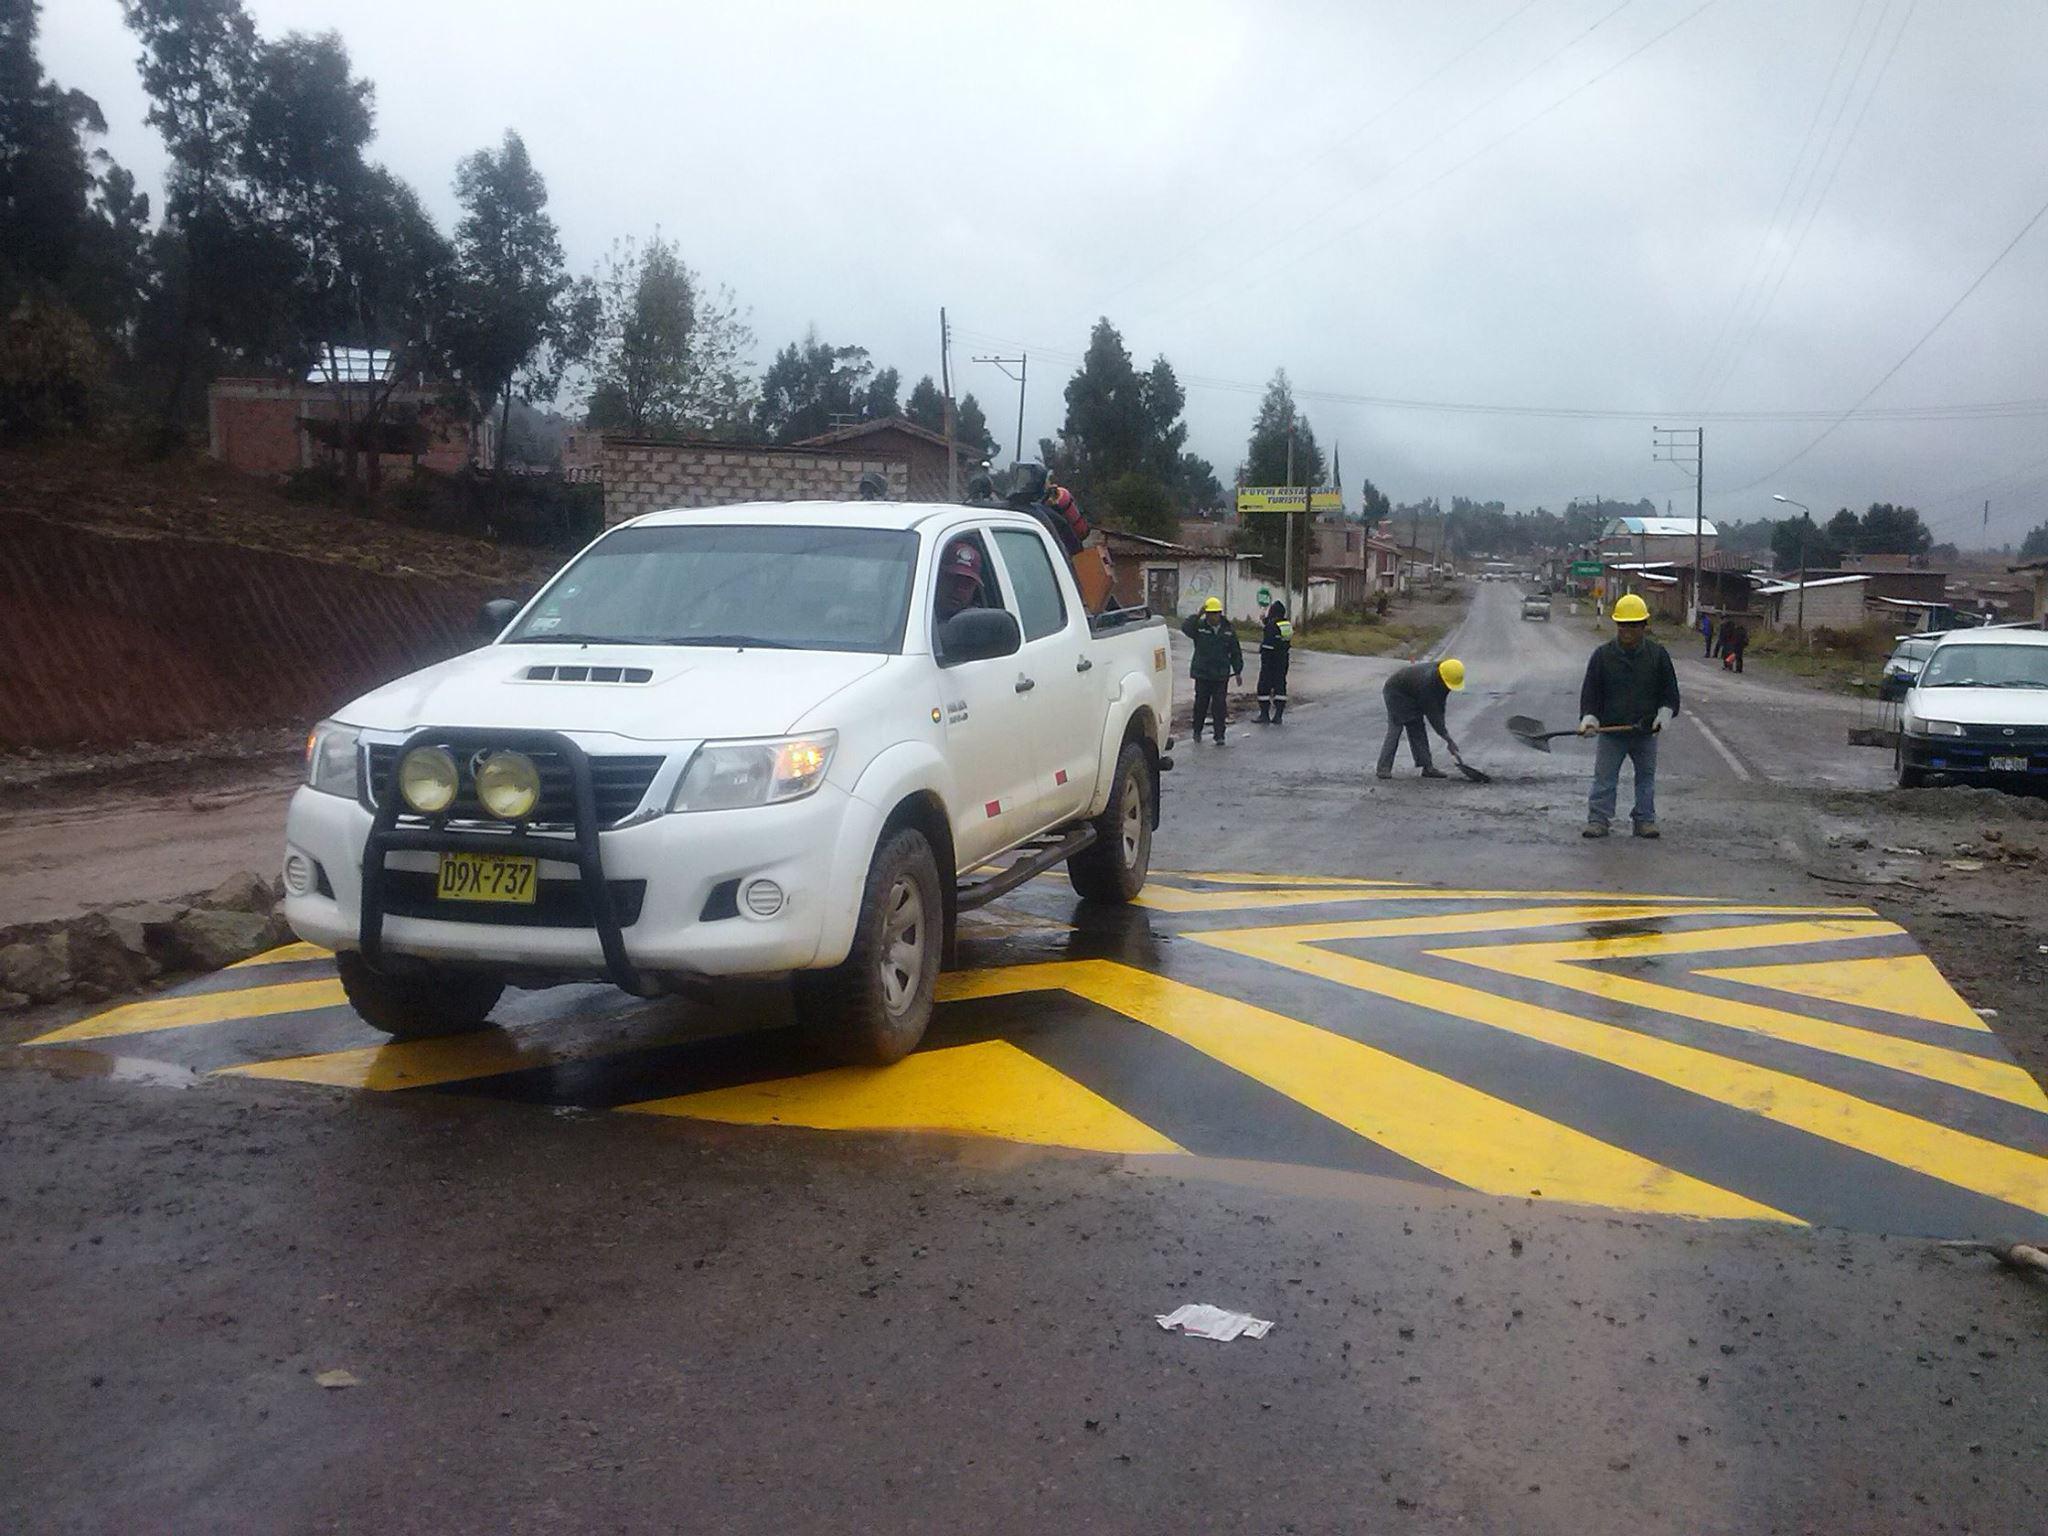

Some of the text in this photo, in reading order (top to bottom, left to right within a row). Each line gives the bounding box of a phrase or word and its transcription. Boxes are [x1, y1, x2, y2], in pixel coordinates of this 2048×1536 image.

[1279, 487, 1340, 496] RESTARANTE
[1267, 496, 1311, 504] TURISTIC
[443, 861, 533, 894] D9X-737
